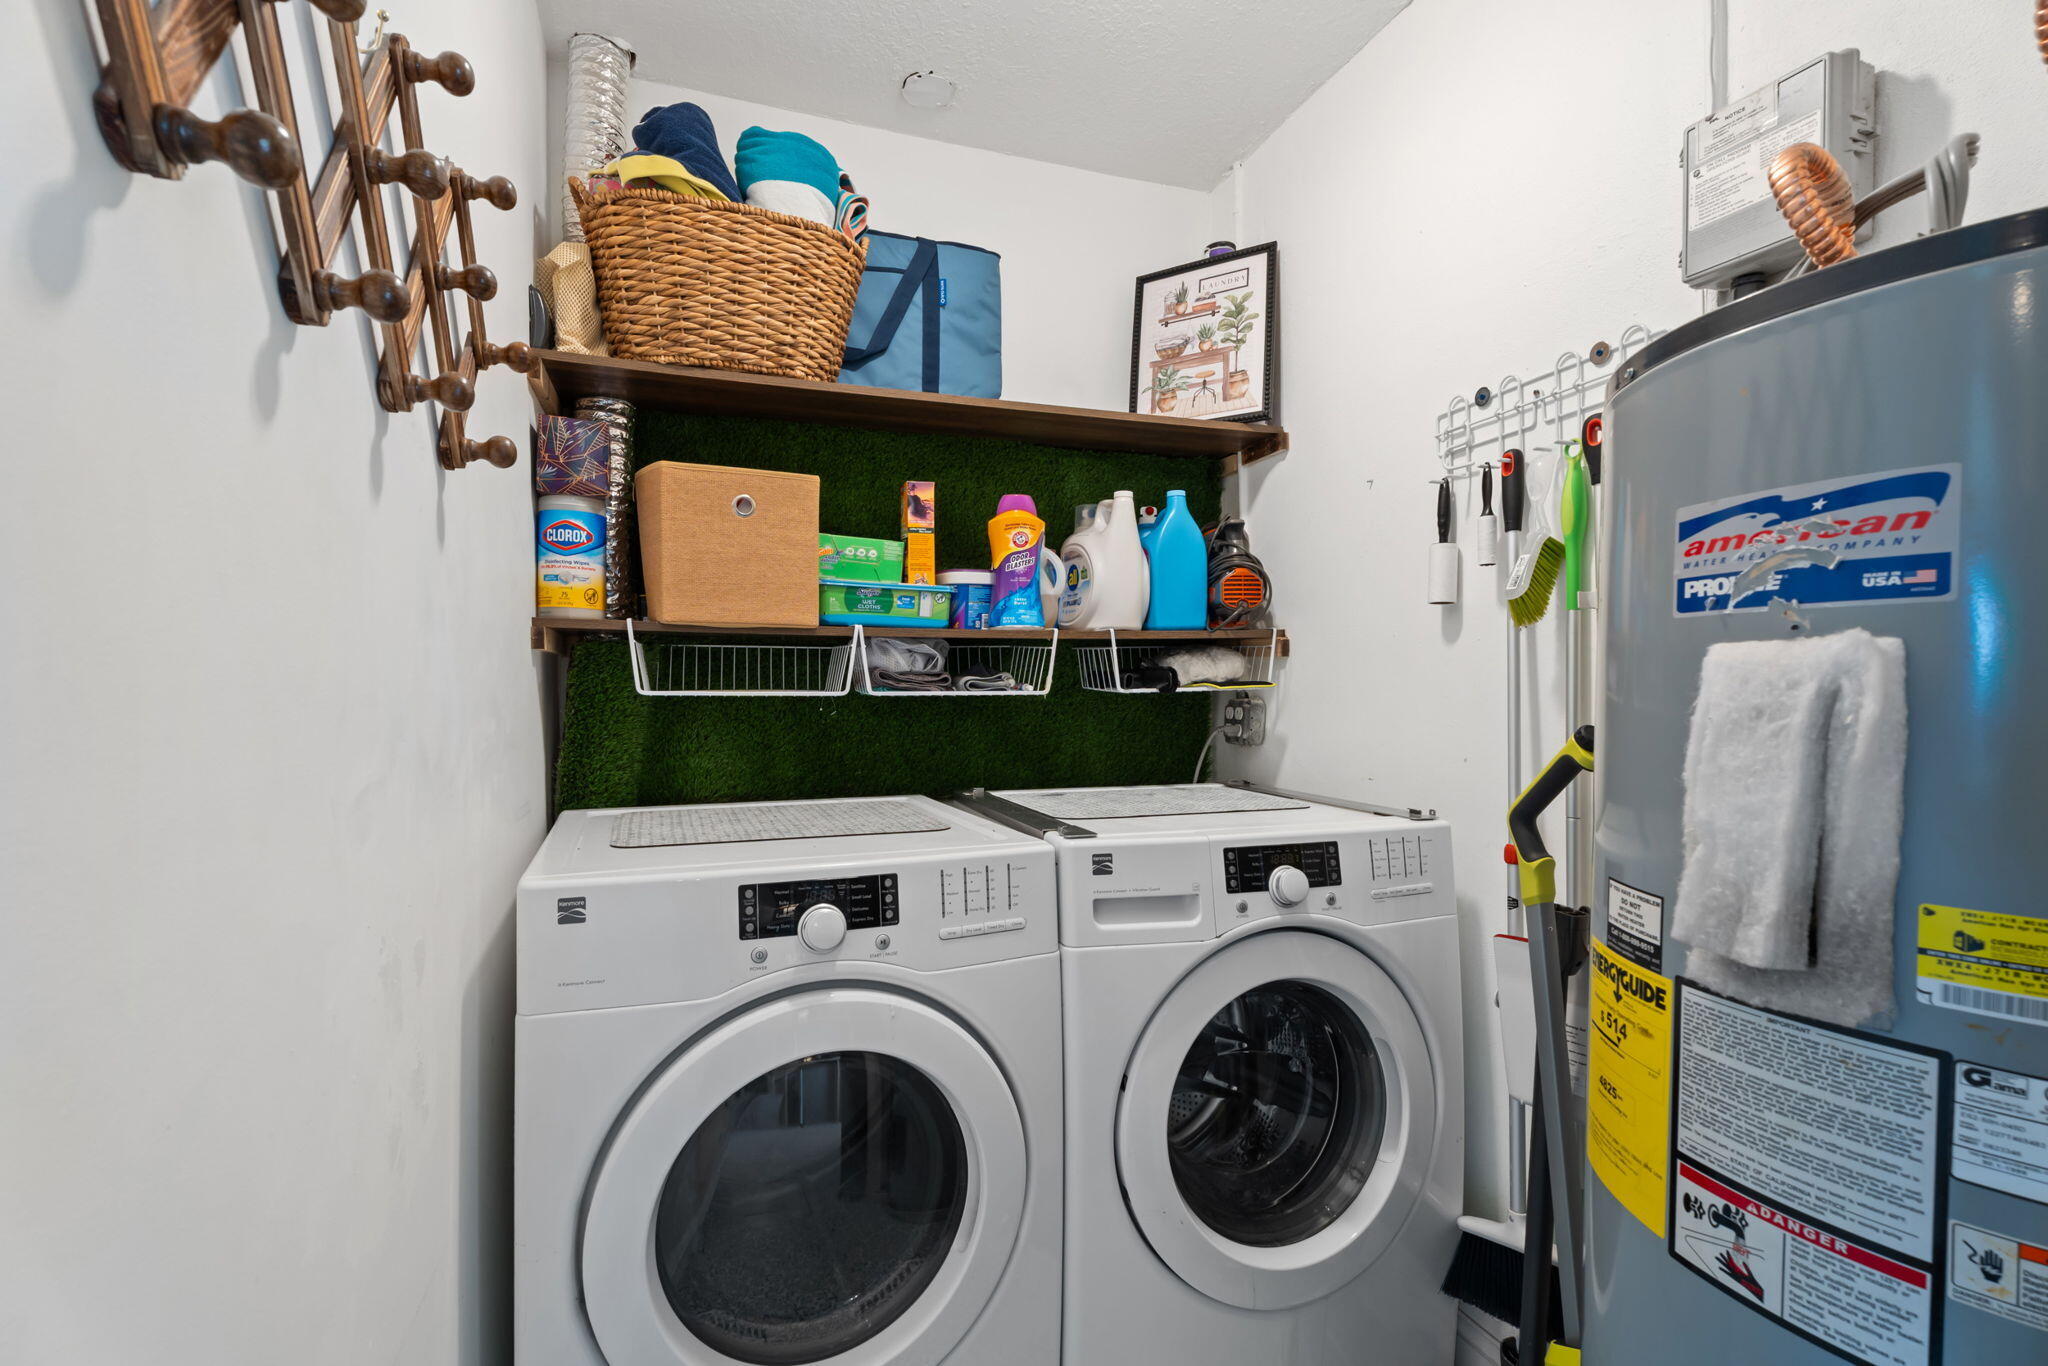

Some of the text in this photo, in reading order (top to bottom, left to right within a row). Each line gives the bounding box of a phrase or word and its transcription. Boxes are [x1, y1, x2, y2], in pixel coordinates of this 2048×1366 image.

[1725, 106, 1746, 120] NOTICE
[1202, 275, 1247, 291] LAUNDRY
[546, 529, 588, 543] CLOROX
[1011, 552, 1029, 563] ODOR
[1683, 556, 1727, 569] WATER
[1817, 535, 1921, 551] OMPANY
[1005, 557, 1035, 571] BLASTERS
[1068, 569, 1078, 586] all
[1862, 576, 1902, 587] USA
[1684, 575, 1784, 598] PROE
[1621, 897, 1641, 911] DO NOT
[1766, 1017, 1812, 1035] IMPORTANT
[1599, 1074, 1618, 1099] 4825
[1729, 1156, 1750, 1171] STATE
[1752, 1167, 1763, 1177] OF
[1766, 1173, 1812, 1200] CALIFORNIA
[1760, 1206, 1848, 1255] DANGER
